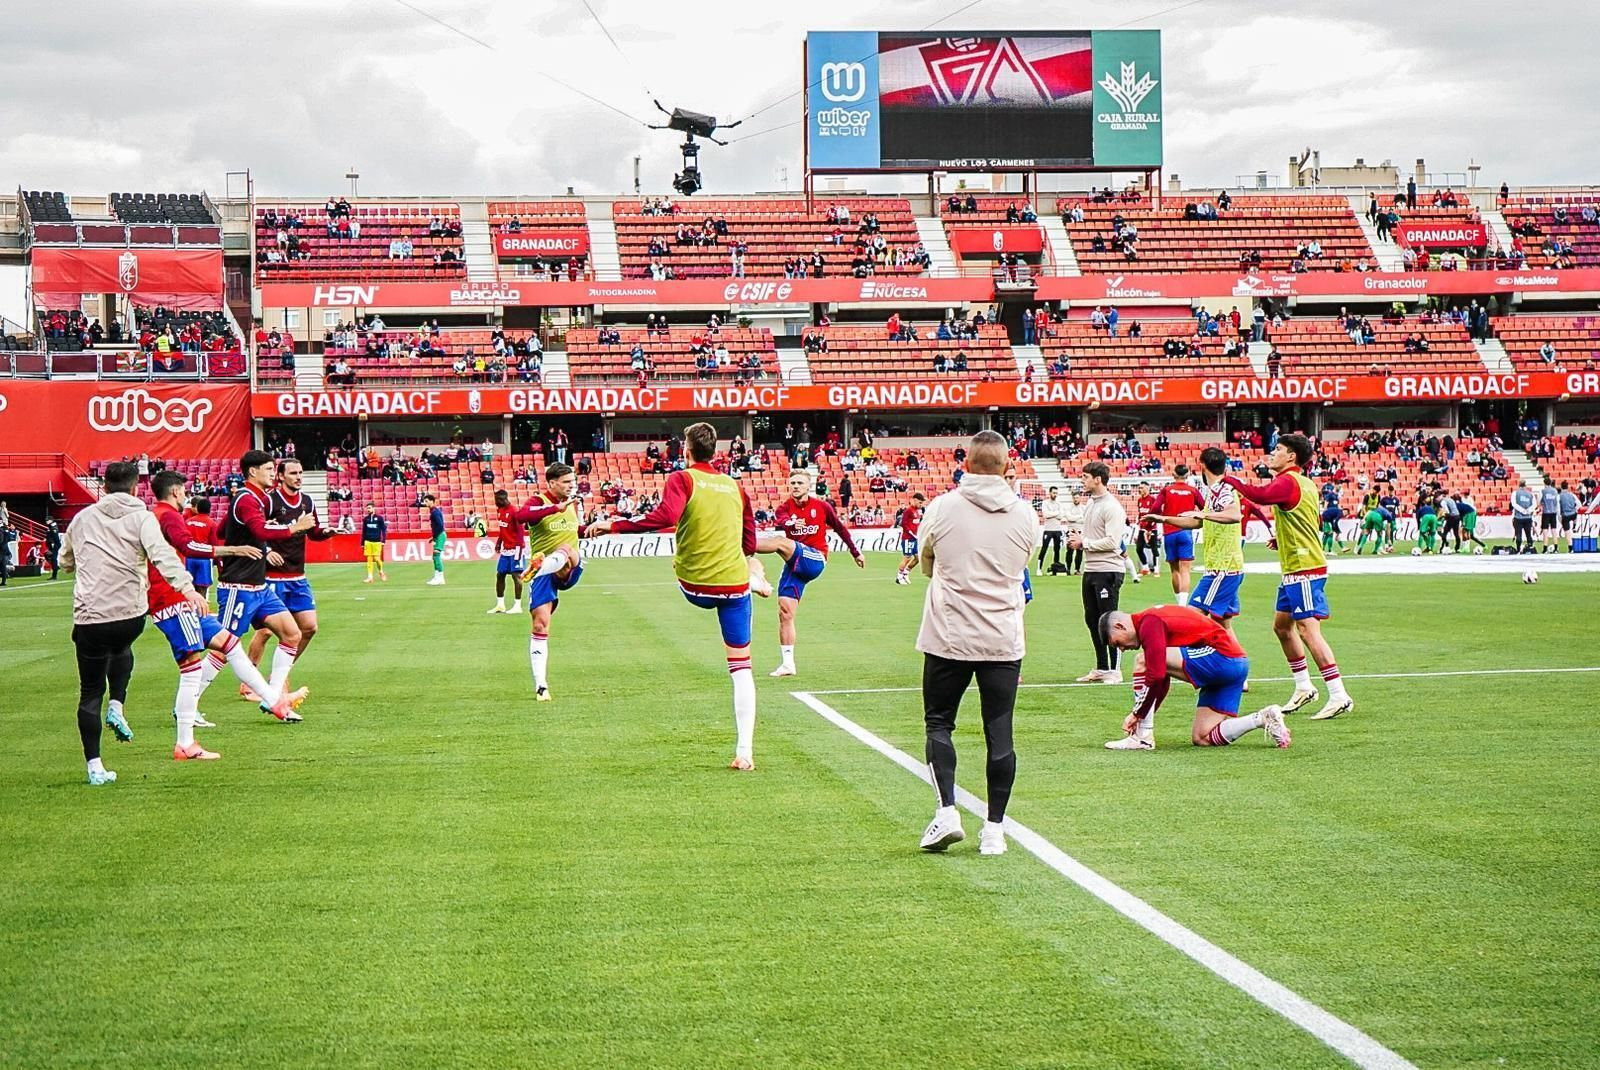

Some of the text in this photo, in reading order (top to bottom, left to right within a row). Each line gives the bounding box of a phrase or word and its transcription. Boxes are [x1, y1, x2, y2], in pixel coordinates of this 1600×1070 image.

[818, 108, 871, 127] wiber
[1097, 113, 1161, 123] CAJA RURAL
[939, 159, 1035, 167] NUEVO LOS CARMENES
[502, 238, 579, 250] GRANADACF
[1406, 229, 1480, 242] GRANADACF
[1364, 276, 1428, 289] Granacolor
[1513, 276, 1558, 286] MicaMotor
[450, 289, 520, 300] BARCALO
[740, 282, 777, 301] CSIF
[1106, 287, 1143, 298] Halcón
[1015, 380, 1163, 403] GRANADACF
[1201, 378, 1348, 400] GRANADACF
[1384, 373, 1530, 397] GRANADACF
[277, 392, 441, 415] GRANADACF
[509, 388, 669, 411] GRANADACF
[828, 384, 978, 406] GRANADACF
[88, 389, 213, 433] wiber
[630, 536, 661, 557] del
[872, 532, 901, 552] del
[233, 601, 245, 619] 4
